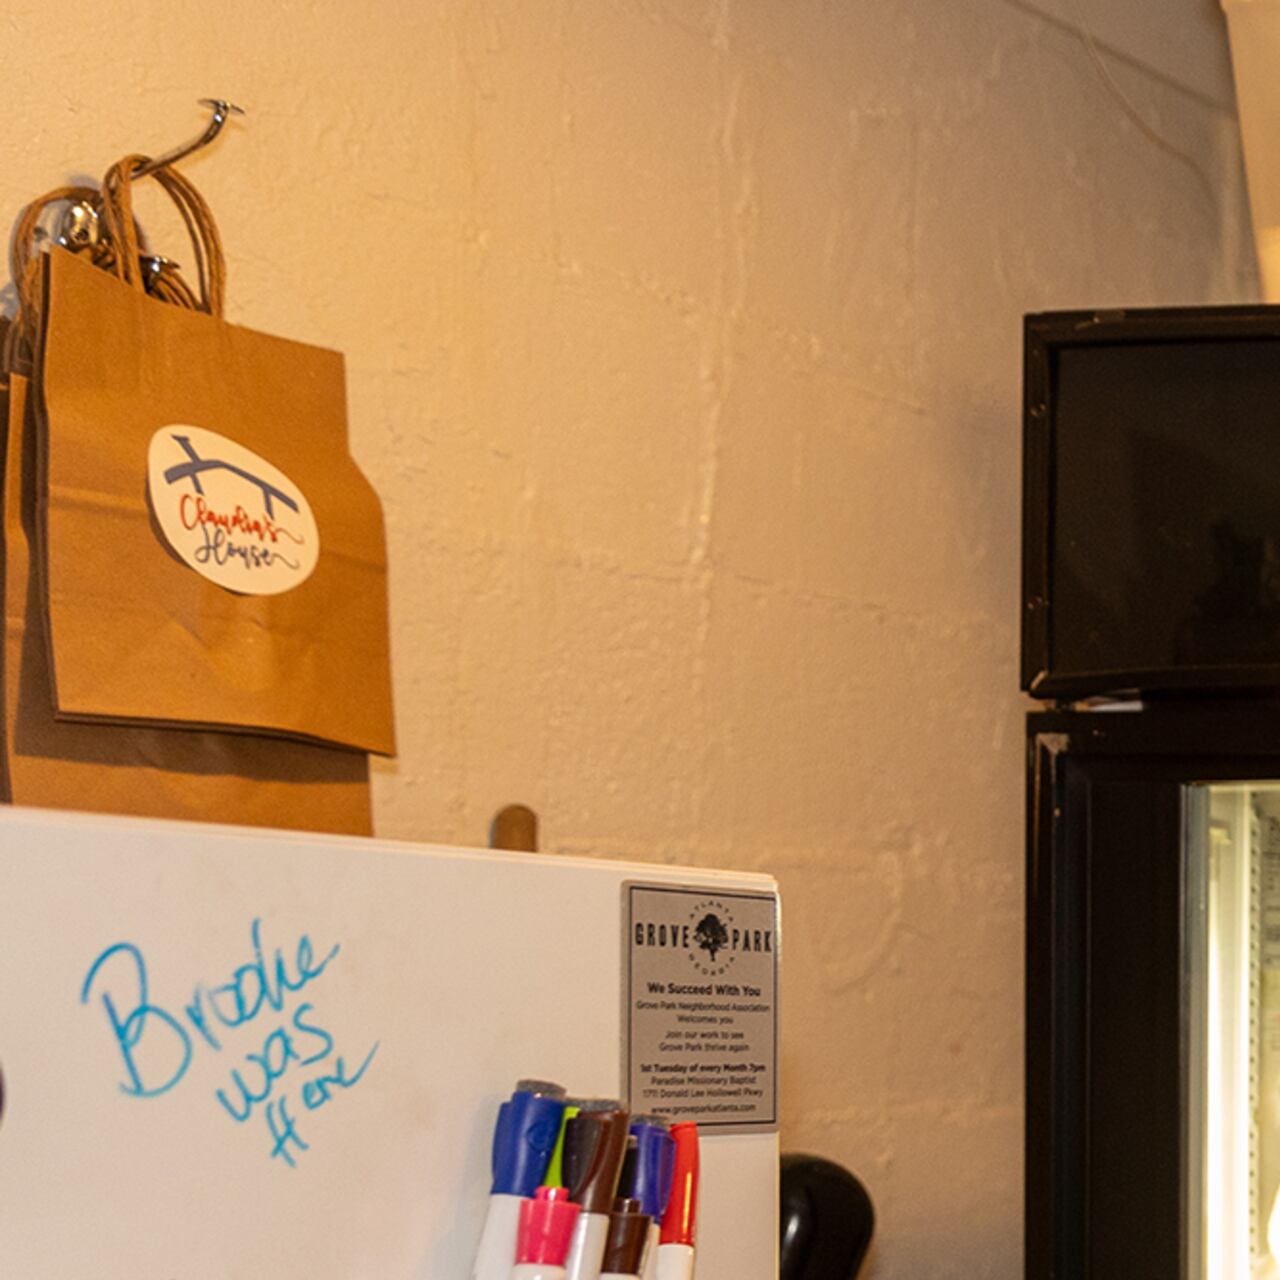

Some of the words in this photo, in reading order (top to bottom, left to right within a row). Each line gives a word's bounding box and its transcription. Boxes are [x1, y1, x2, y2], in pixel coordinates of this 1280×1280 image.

[195, 521, 299, 570] House
[635, 923, 690, 948] GROVE
[732, 929, 772, 952] PARK
[647, 982, 665, 993] We
[667, 983, 713, 996] Succeed
[715, 984, 740, 996] With
[743, 986, 761, 996] You
[636, 1001, 659, 1010] Grove
[660, 1001, 676, 1010] Park
[678, 1002, 730, 1012] Neighborhood
[732, 1003, 770, 1012] Association
[719, 1017, 734, 1025] you
[684, 1031, 698, 1039] our
[700, 1031, 719, 1039] work
[659, 1042, 684, 1051] Grove
[685, 1042, 702, 1051] Park
[704, 1043, 728, 1051] thrive
[216, 1002, 333, 1122] was
[654, 1064, 687, 1073] Tuesday
[689, 1064, 699, 1072] of
[700, 1065, 721, 1073] every
[723, 1064, 747, 1072] Month
[651, 1076, 685, 1086] Paradise
